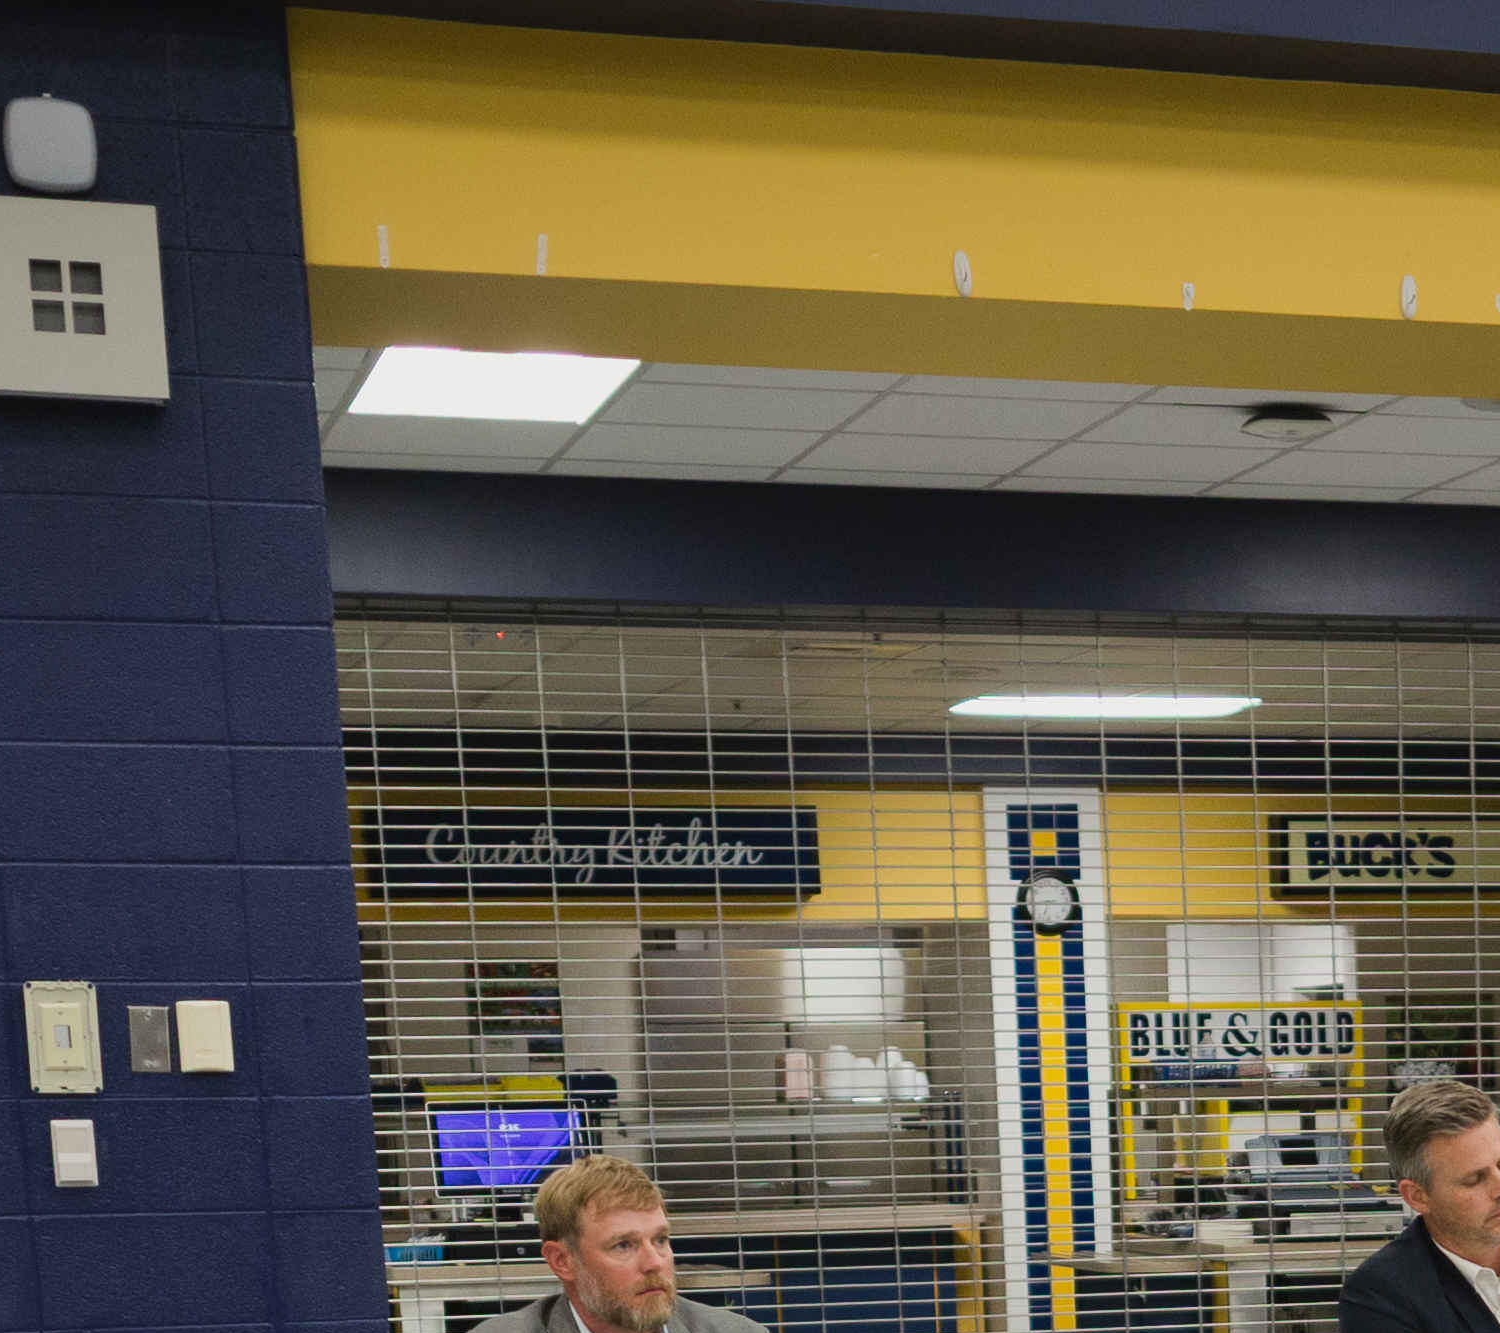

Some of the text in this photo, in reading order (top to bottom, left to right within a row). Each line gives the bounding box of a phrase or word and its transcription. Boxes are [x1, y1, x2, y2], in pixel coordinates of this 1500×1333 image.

[424, 817, 764, 885] Country Kitchen
[1130, 1011, 1355, 1058] BLUE & GOLD
